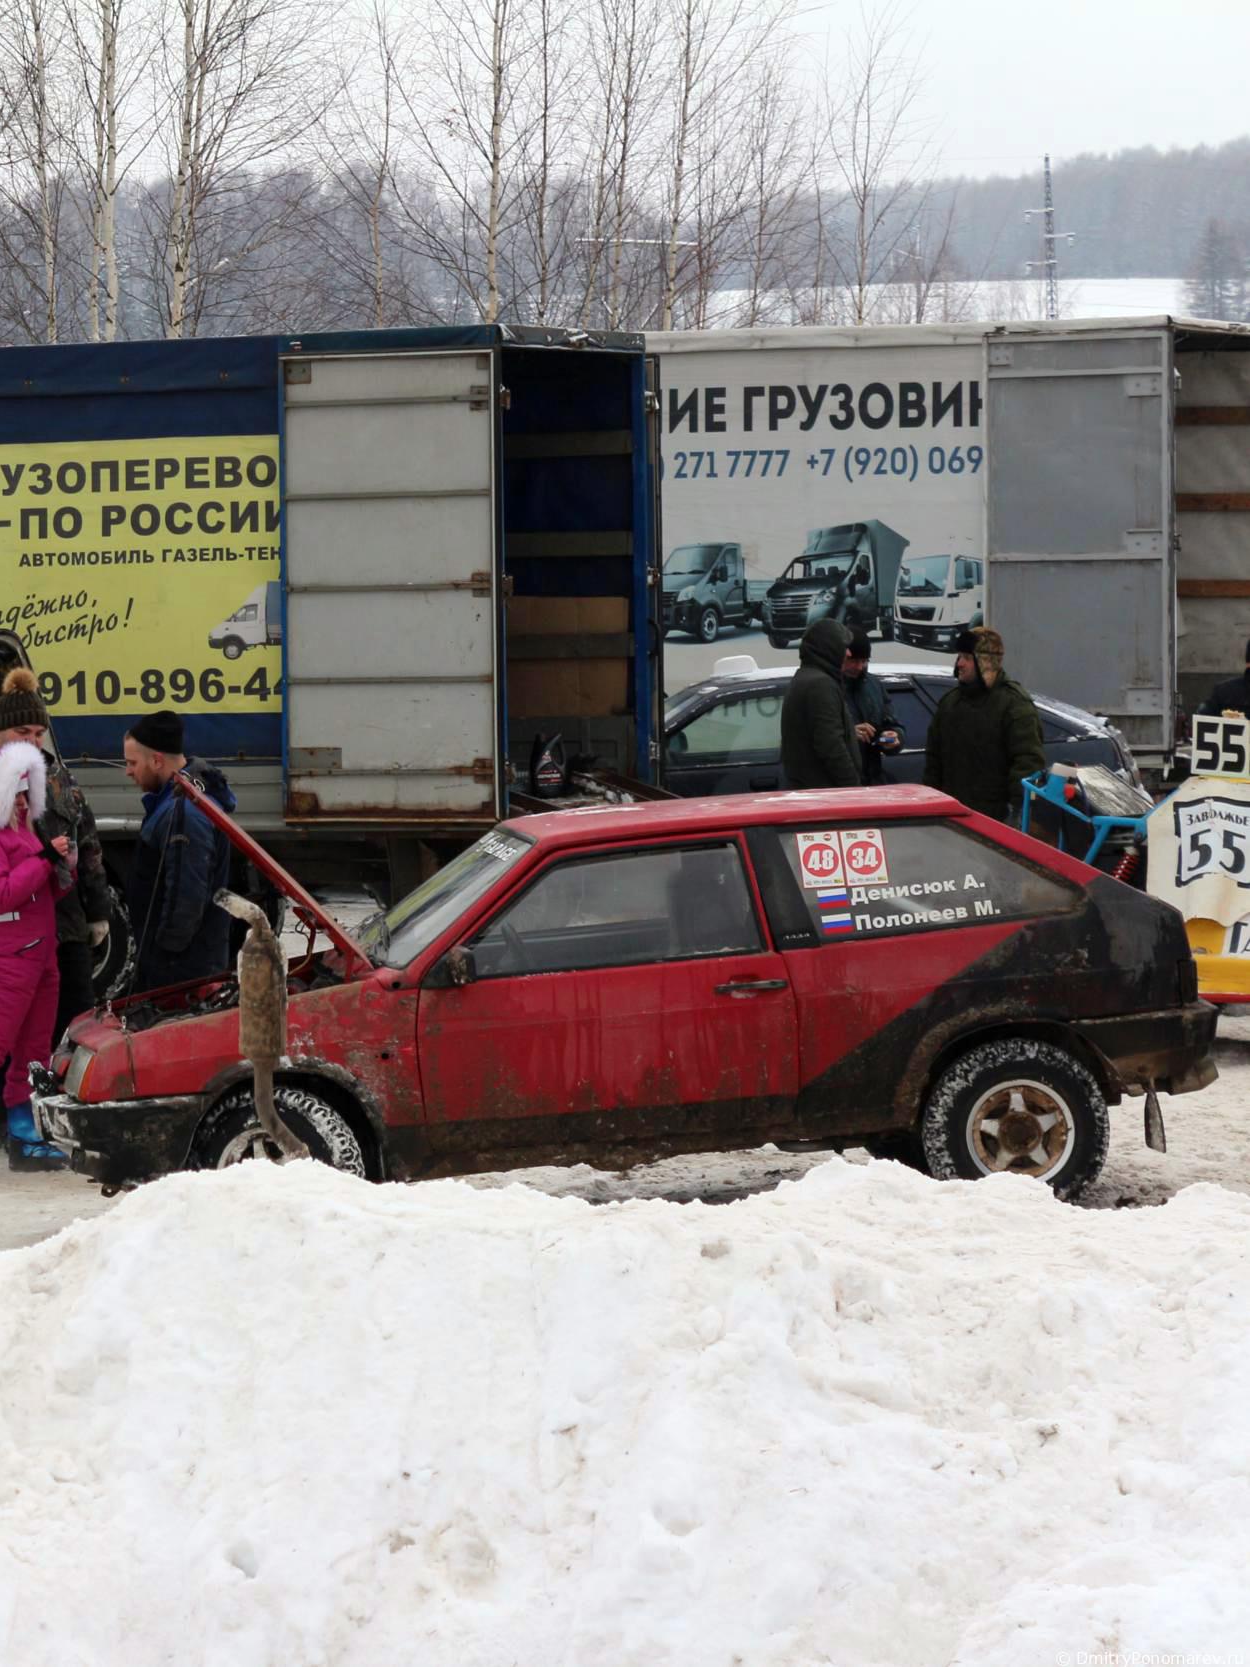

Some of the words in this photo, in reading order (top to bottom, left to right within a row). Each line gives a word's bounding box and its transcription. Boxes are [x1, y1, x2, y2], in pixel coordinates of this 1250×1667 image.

[659, 387, 727, 433] ИЕ
[674, 451, 718, 478] 271
[726, 450, 790, 477] 7777
[806, 448, 836, 476] +7
[844, 444, 919, 482] (920)
[928, 446, 983, 474] 069
[19, 506, 83, 539] ПО
[19, 551, 154, 567] АВТОМОБИЛЬ
[22, 598, 134, 649] быстро!
[1195, 721, 1246, 773] 55
[807, 849, 835, 871] 48
[851, 847, 878, 869] 34
[1187, 828, 1246, 874] 55
[851, 879, 957, 905] Денисюк
[963, 874, 986, 890] А.
[855, 905, 969, 931] Полонеев
[974, 900, 1001, 916] М.
